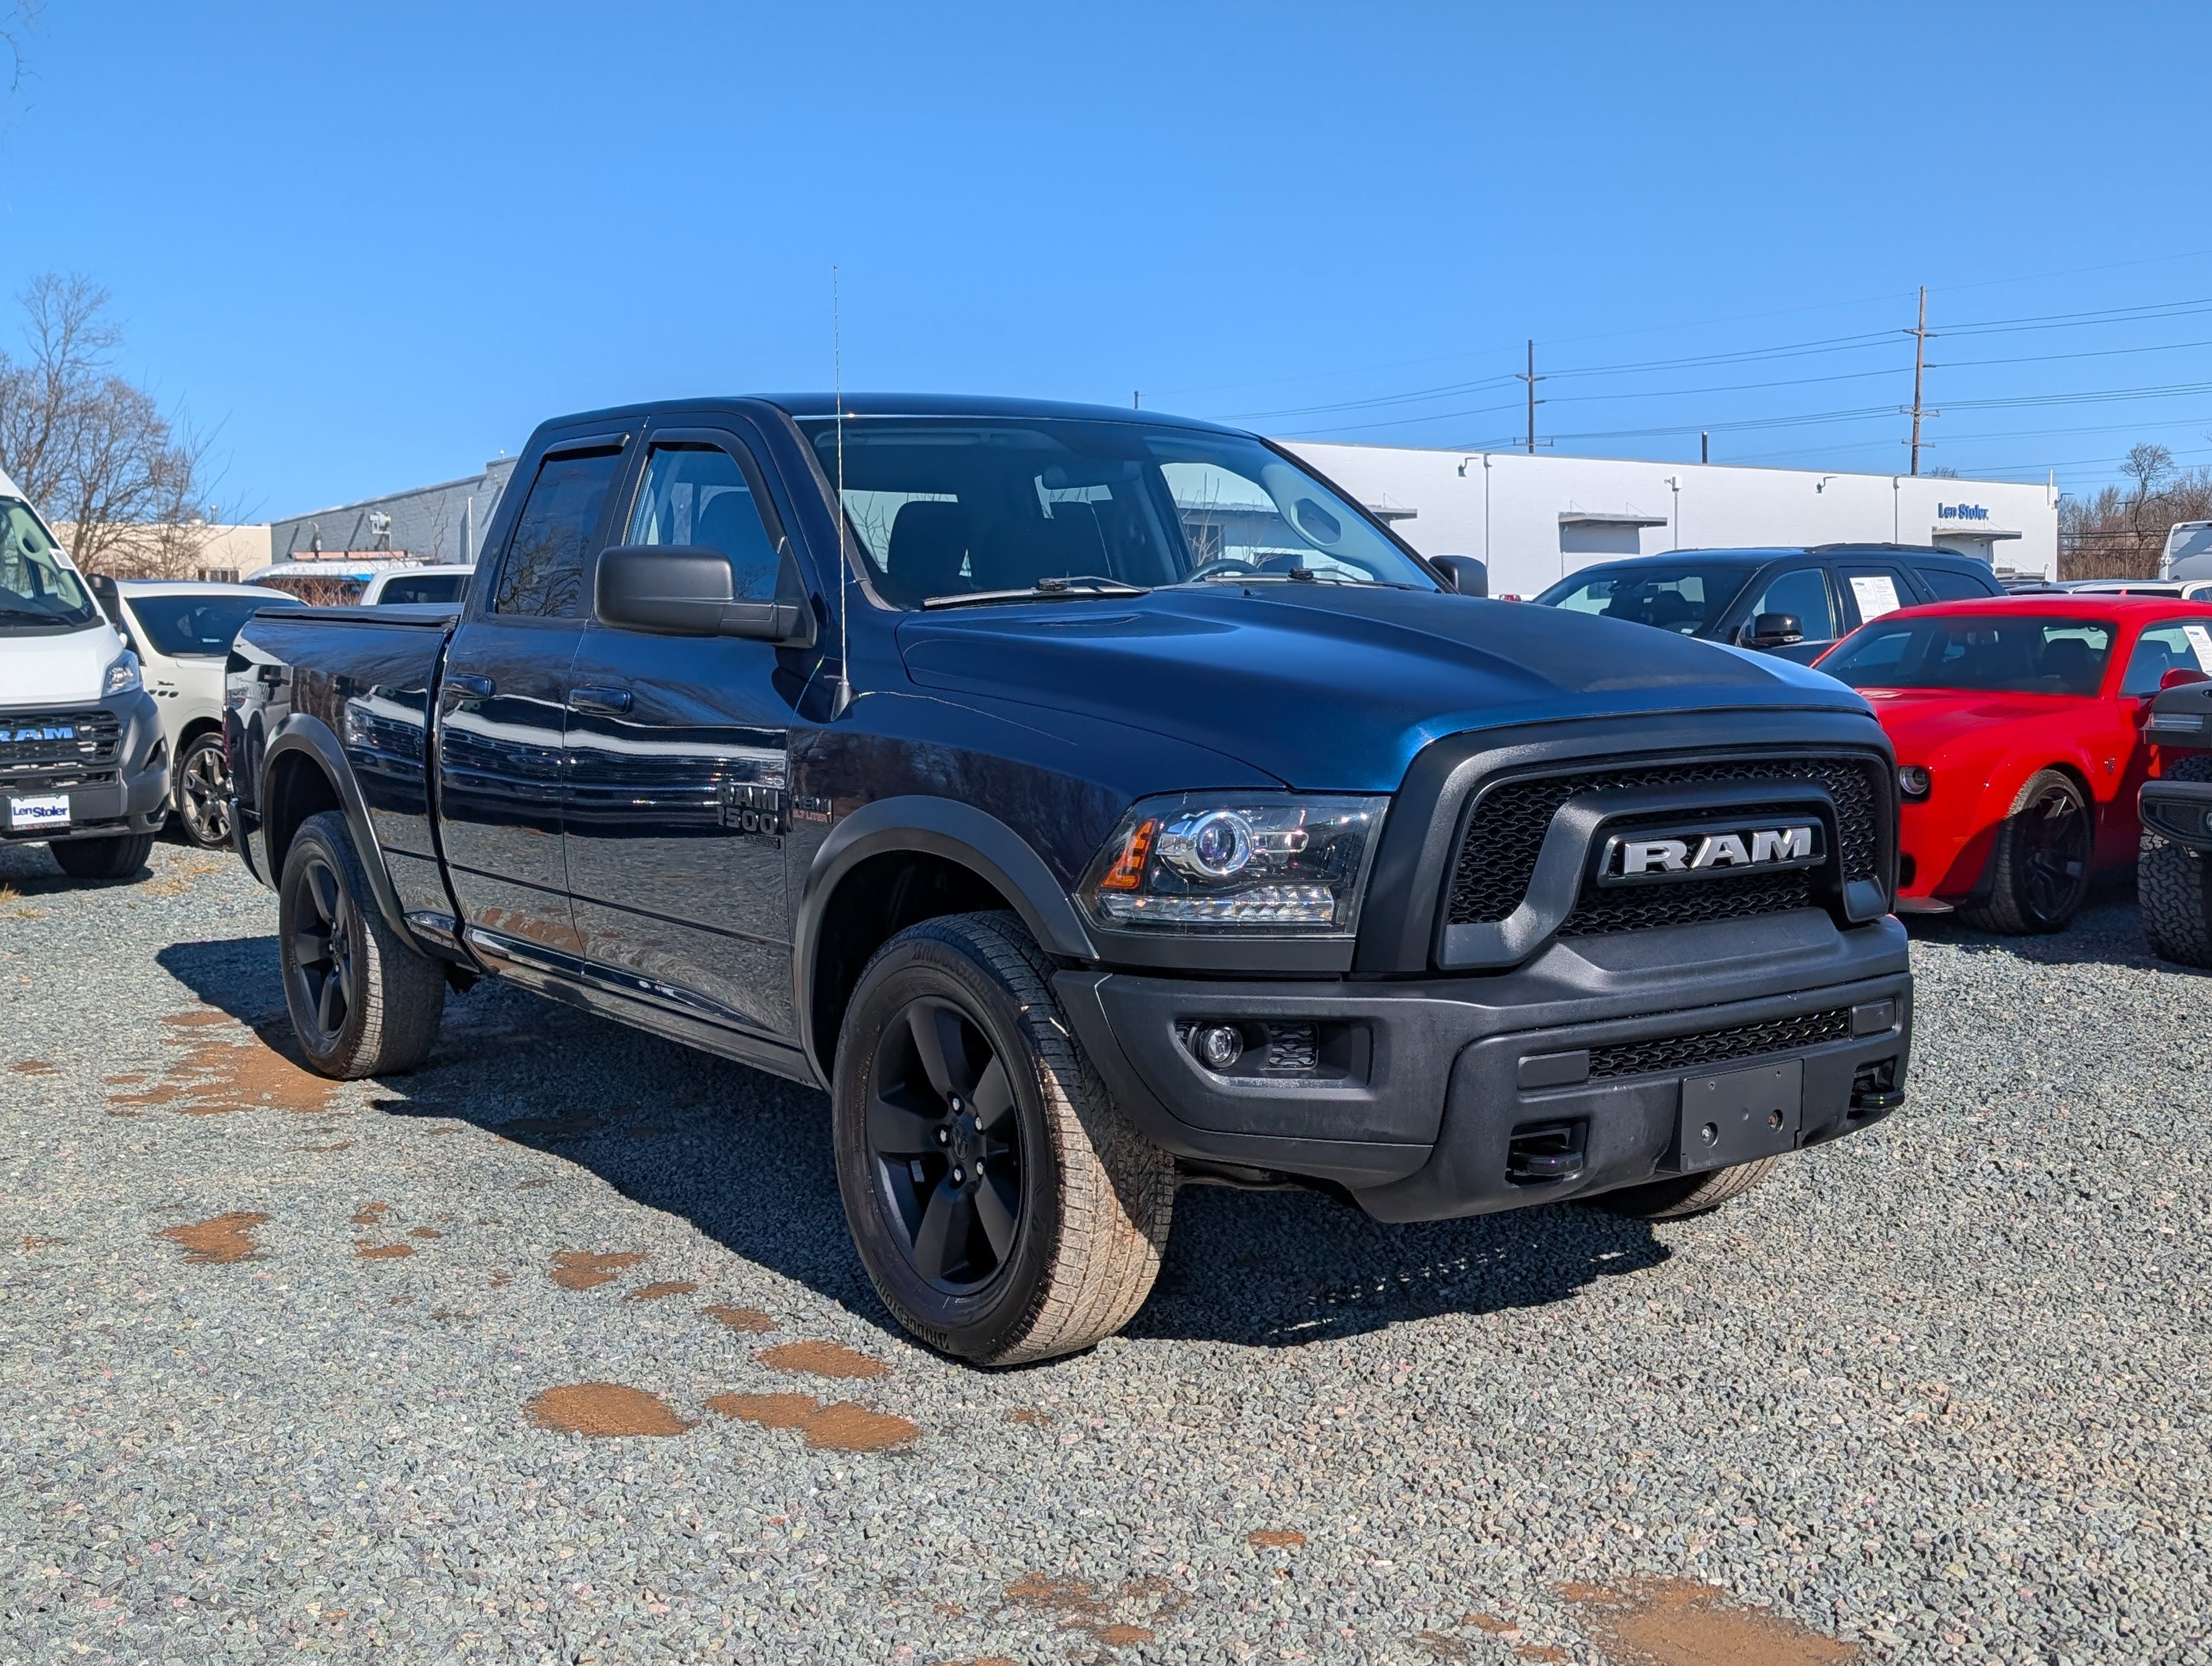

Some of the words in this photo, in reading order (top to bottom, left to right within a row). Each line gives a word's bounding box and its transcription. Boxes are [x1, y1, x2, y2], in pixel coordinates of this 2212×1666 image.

[1938, 503, 1957, 519] Len
[717, 783, 779, 811] RAM
[792, 795, 829, 812] HEMI
[717, 806, 779, 835] 1500
[806, 811, 828, 823] LITER
[1623, 827, 1812, 875] RAM
